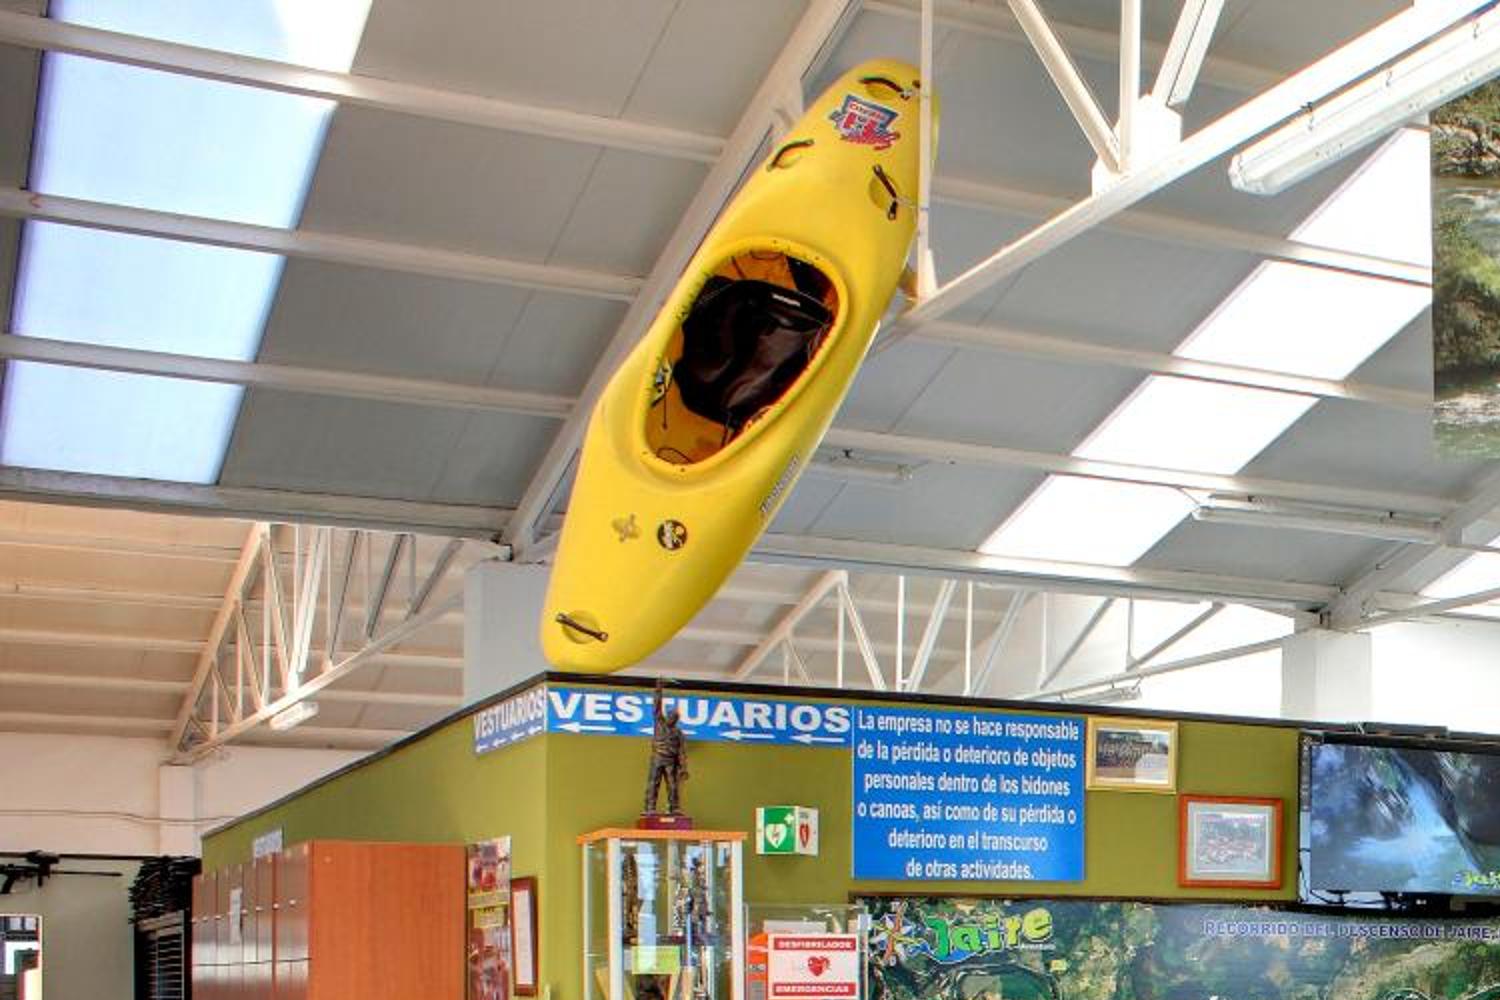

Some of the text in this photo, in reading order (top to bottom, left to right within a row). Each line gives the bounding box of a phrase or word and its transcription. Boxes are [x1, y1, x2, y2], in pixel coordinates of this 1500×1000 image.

[474, 688, 544, 740] VESTUARIOS
[858, 710, 1079, 745] La empresa no se hace responsable
[857, 740, 1077, 772] de la pérdida o deterioro de objetos
[864, 772, 1071, 796] personales dentro de los bidones
[857, 800, 1077, 826] o canoas, así como de su pérdida o
[888, 828, 1048, 852] deterioro en el transcurso
[906, 858, 1035, 880] de otras actividades.
[926, 907, 1054, 961] Jaire
[1203, 919, 1299, 938] RECORRIDO
[1302, 921, 1335, 938] DEL
[1340, 922, 1422, 939] DESCENSO
[774, 984, 850, 993] EMERGENCIAS
